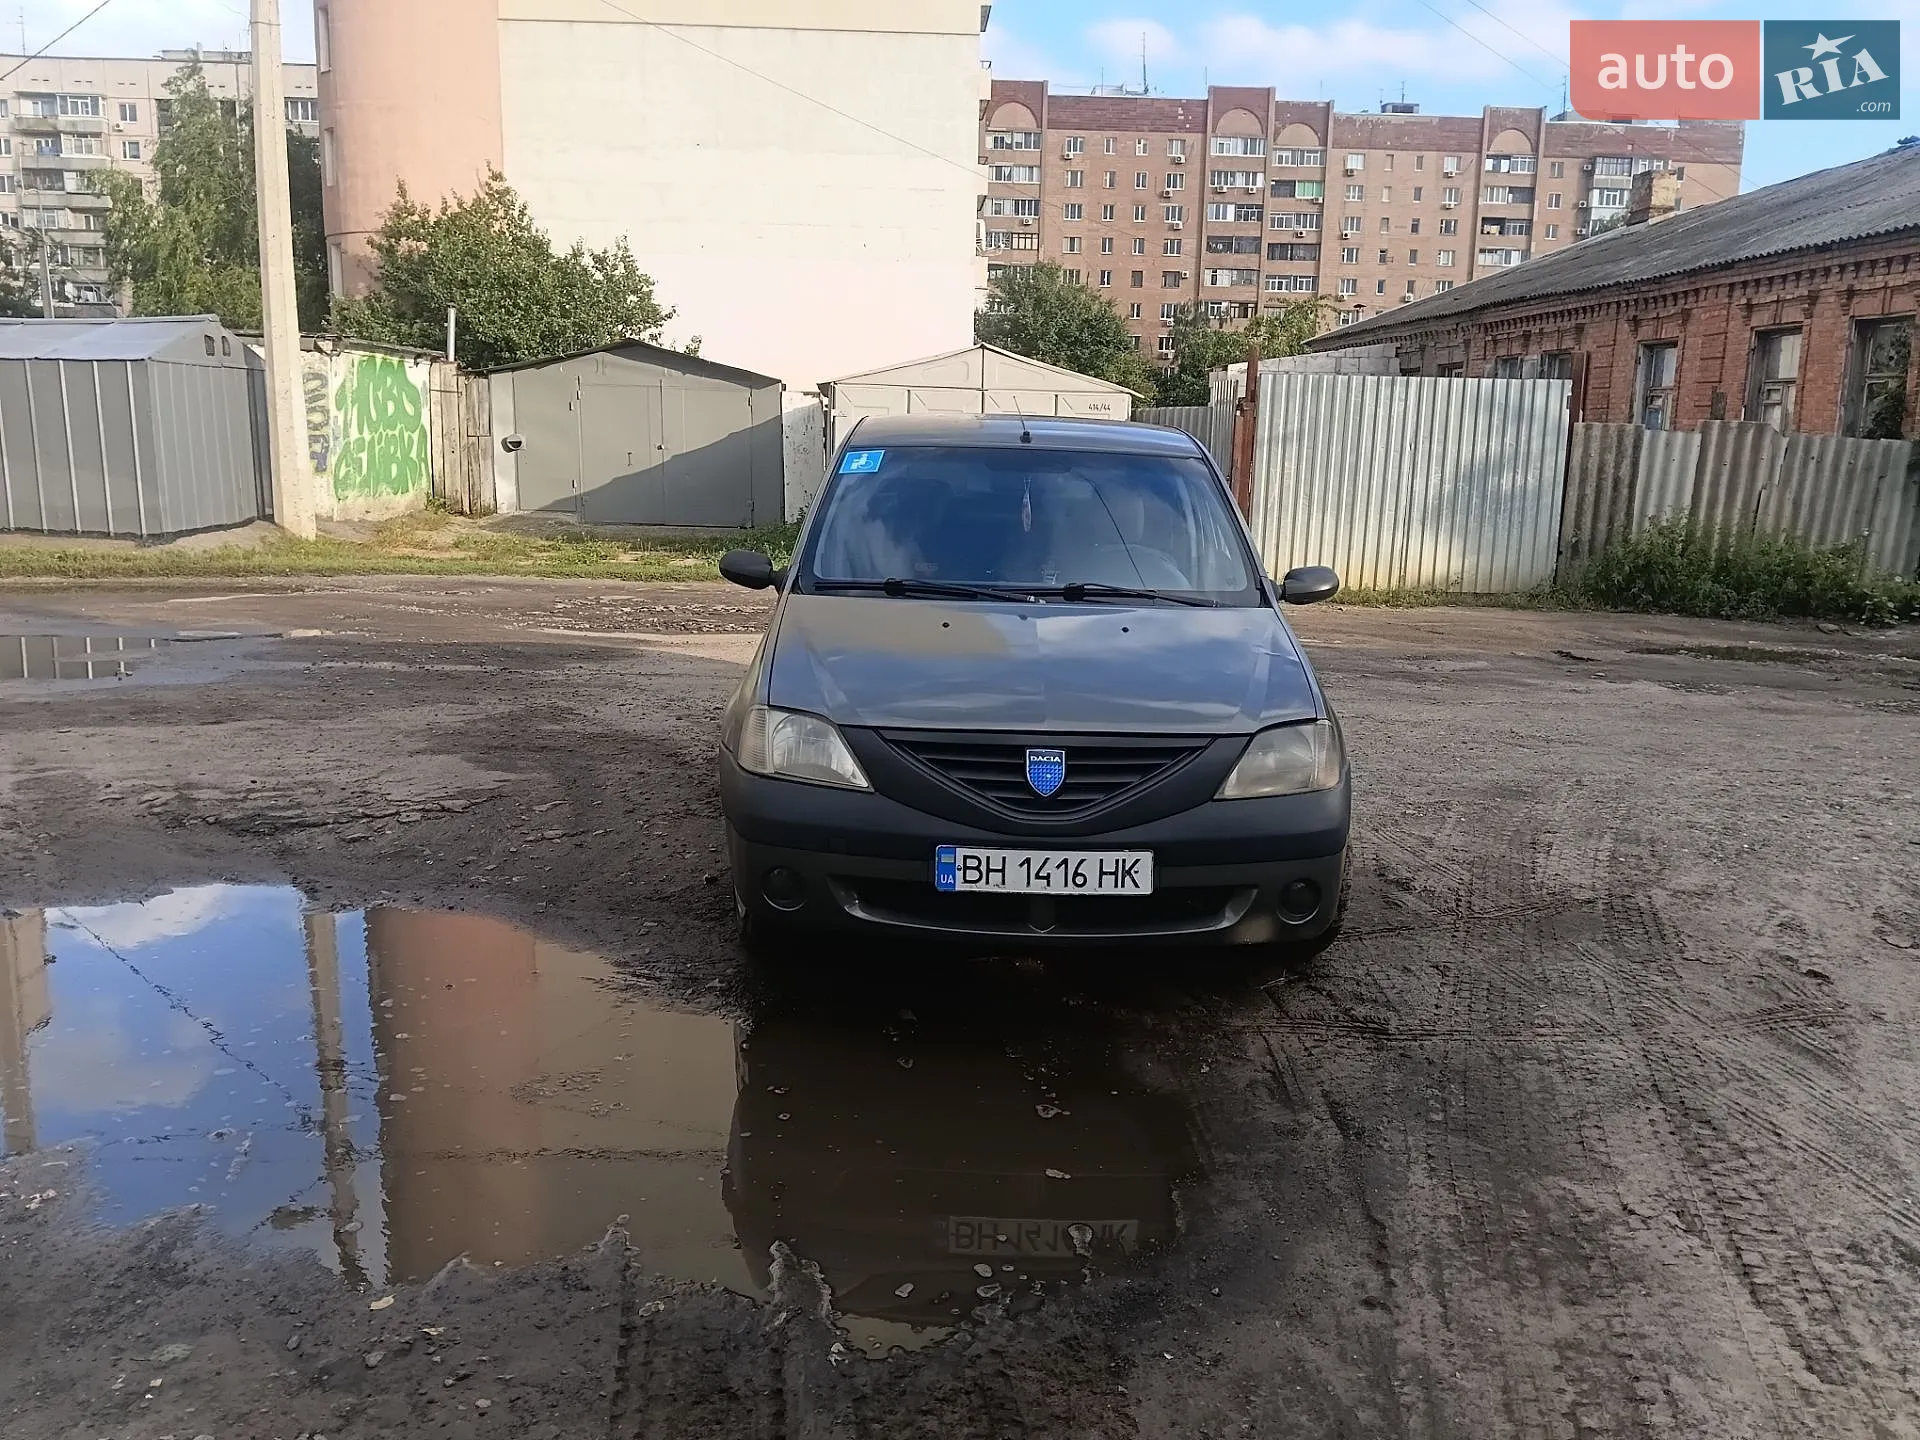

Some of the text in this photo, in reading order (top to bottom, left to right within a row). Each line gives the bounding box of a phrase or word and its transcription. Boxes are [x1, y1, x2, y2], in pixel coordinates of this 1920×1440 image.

[1030, 755, 1062, 763] DACIA
[961, 854, 1142, 889] BH 1416 HK
[940, 874, 955, 884] UA
